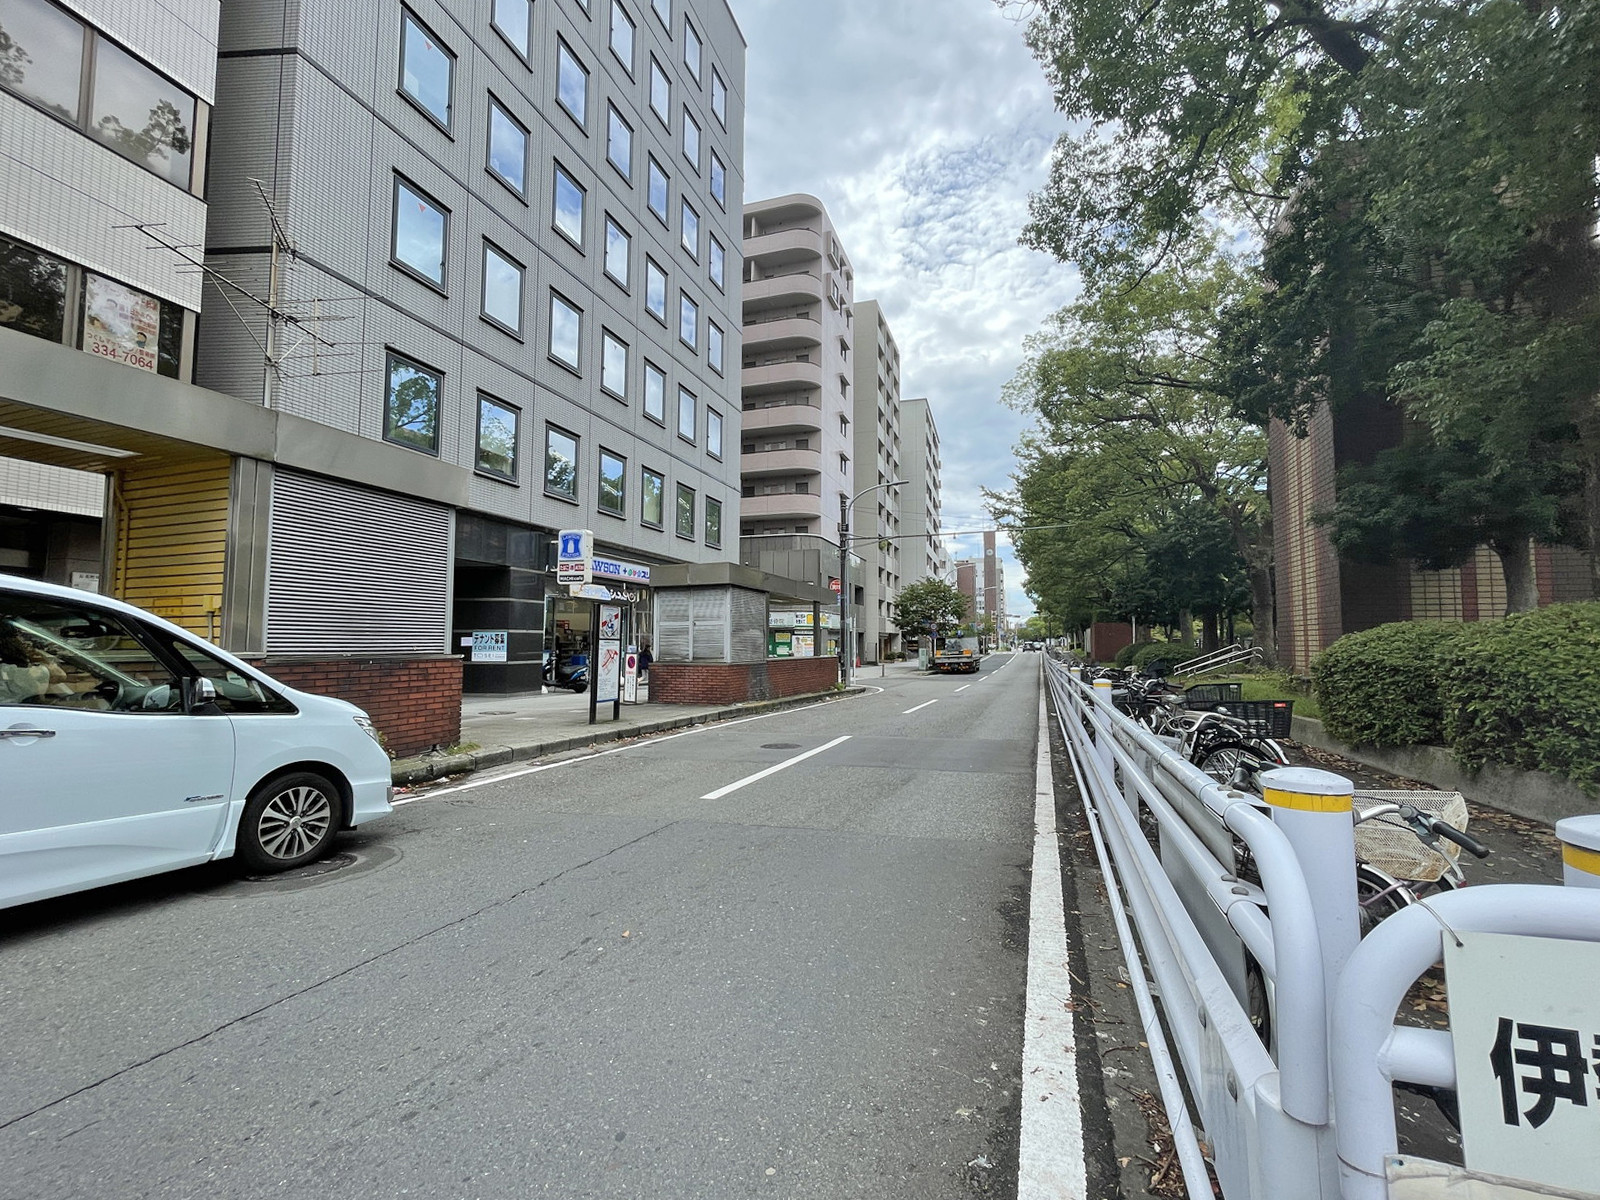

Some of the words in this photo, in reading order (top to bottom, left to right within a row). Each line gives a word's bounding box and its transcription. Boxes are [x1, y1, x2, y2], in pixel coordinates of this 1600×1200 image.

[92, 342, 153, 370] 334-7064
[591, 559, 621, 575] AWSON
[474, 633, 505, 645] テナント募集
[1489, 1016, 1600, 1130] 伊
